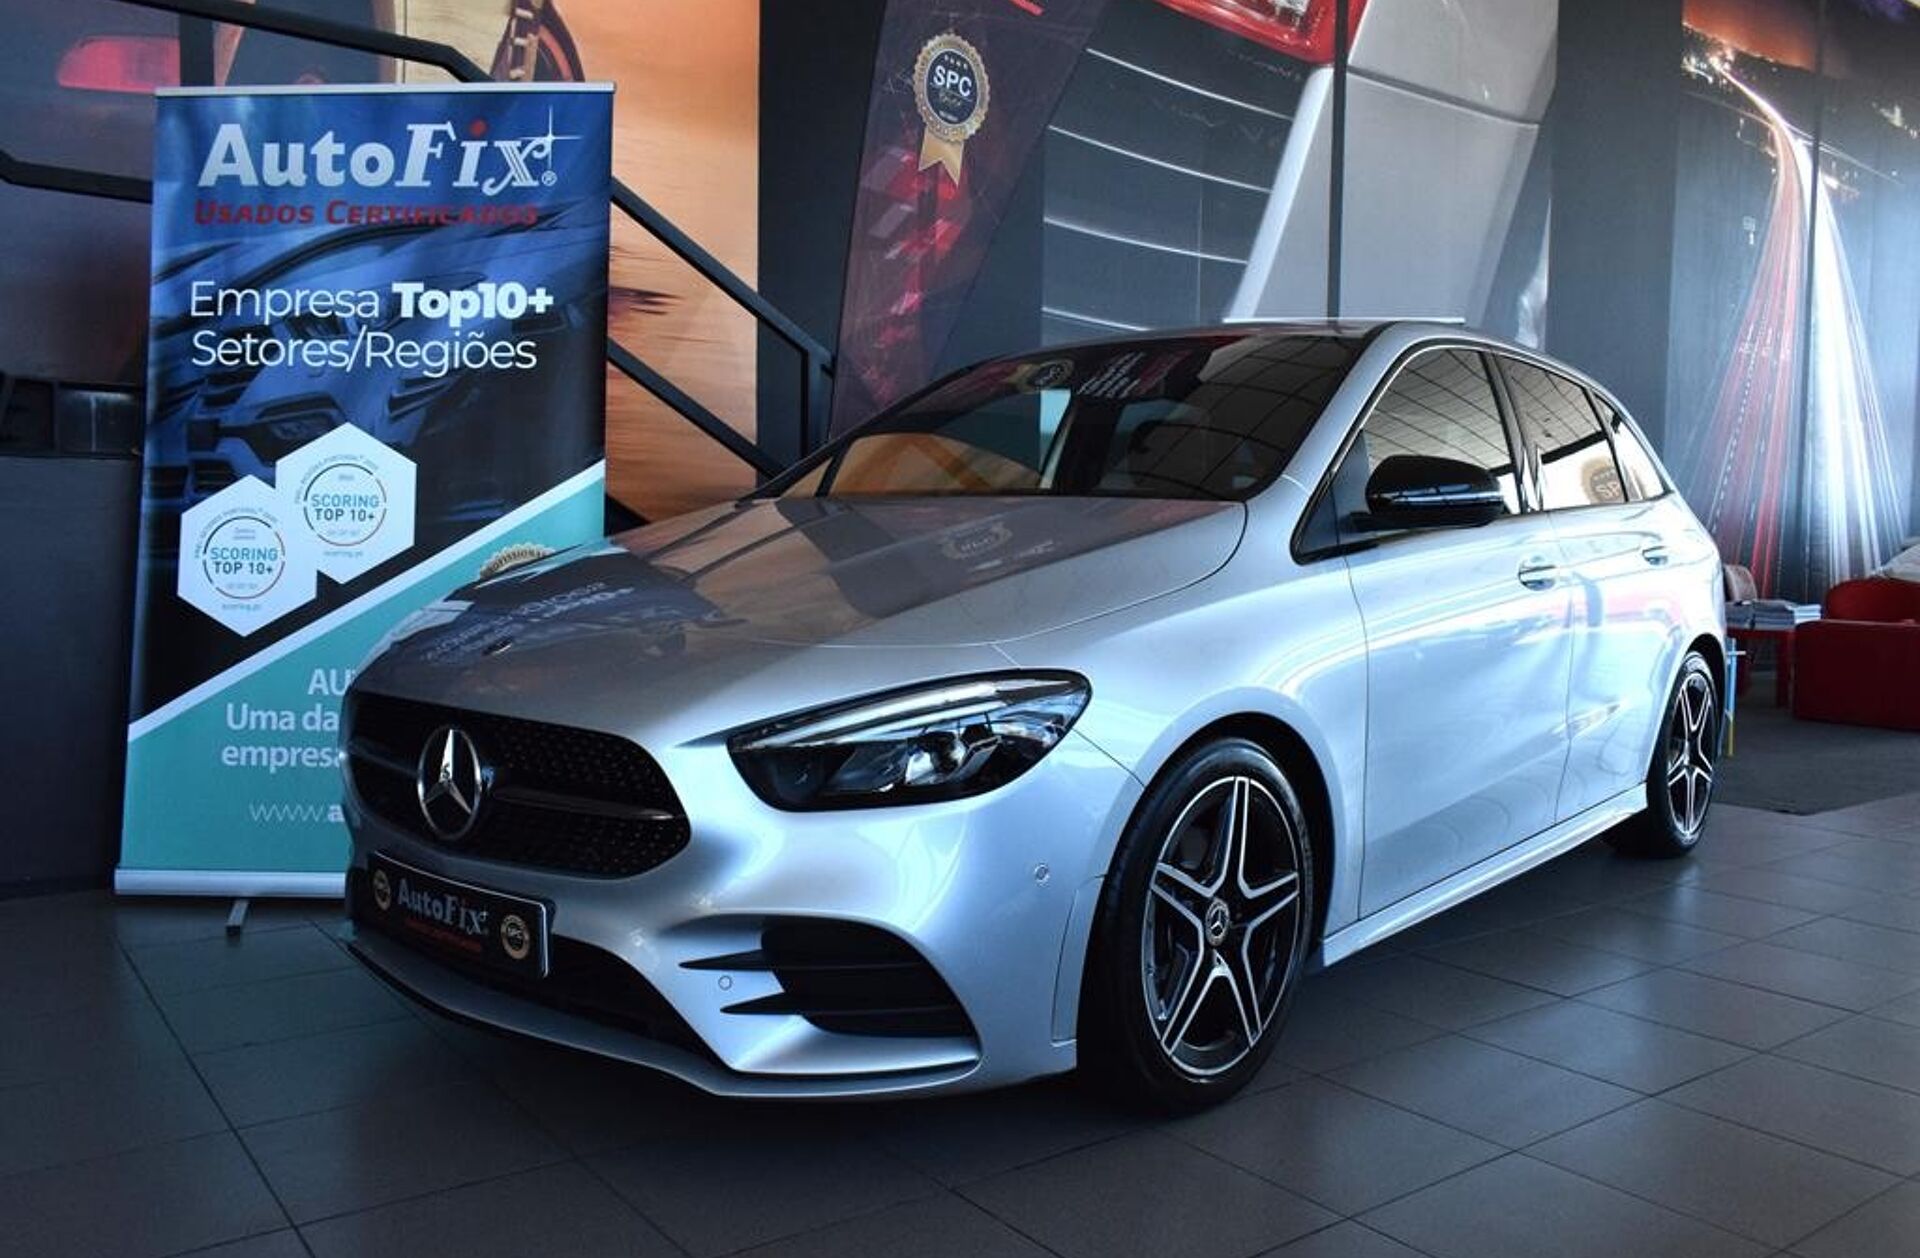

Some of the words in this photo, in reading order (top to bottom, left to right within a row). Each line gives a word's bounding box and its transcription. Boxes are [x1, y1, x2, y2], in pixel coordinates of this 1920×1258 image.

[933, 65, 972, 97] SPC
[194, 200, 314, 225] USADOS
[325, 200, 538, 226] CERTIFICADOS
[189, 281, 380, 323] Empresa
[391, 281, 554, 327] Top10+
[191, 323, 537, 377] Setores/Regiões
[311, 493, 380, 508] SCORING
[314, 508, 345, 522] TOP
[350, 508, 375, 523] 10+
[209, 547, 279, 561] SCORING
[213, 561, 243, 575] TOP
[248, 562, 273, 575] 10+
[226, 703, 295, 731] Uma
